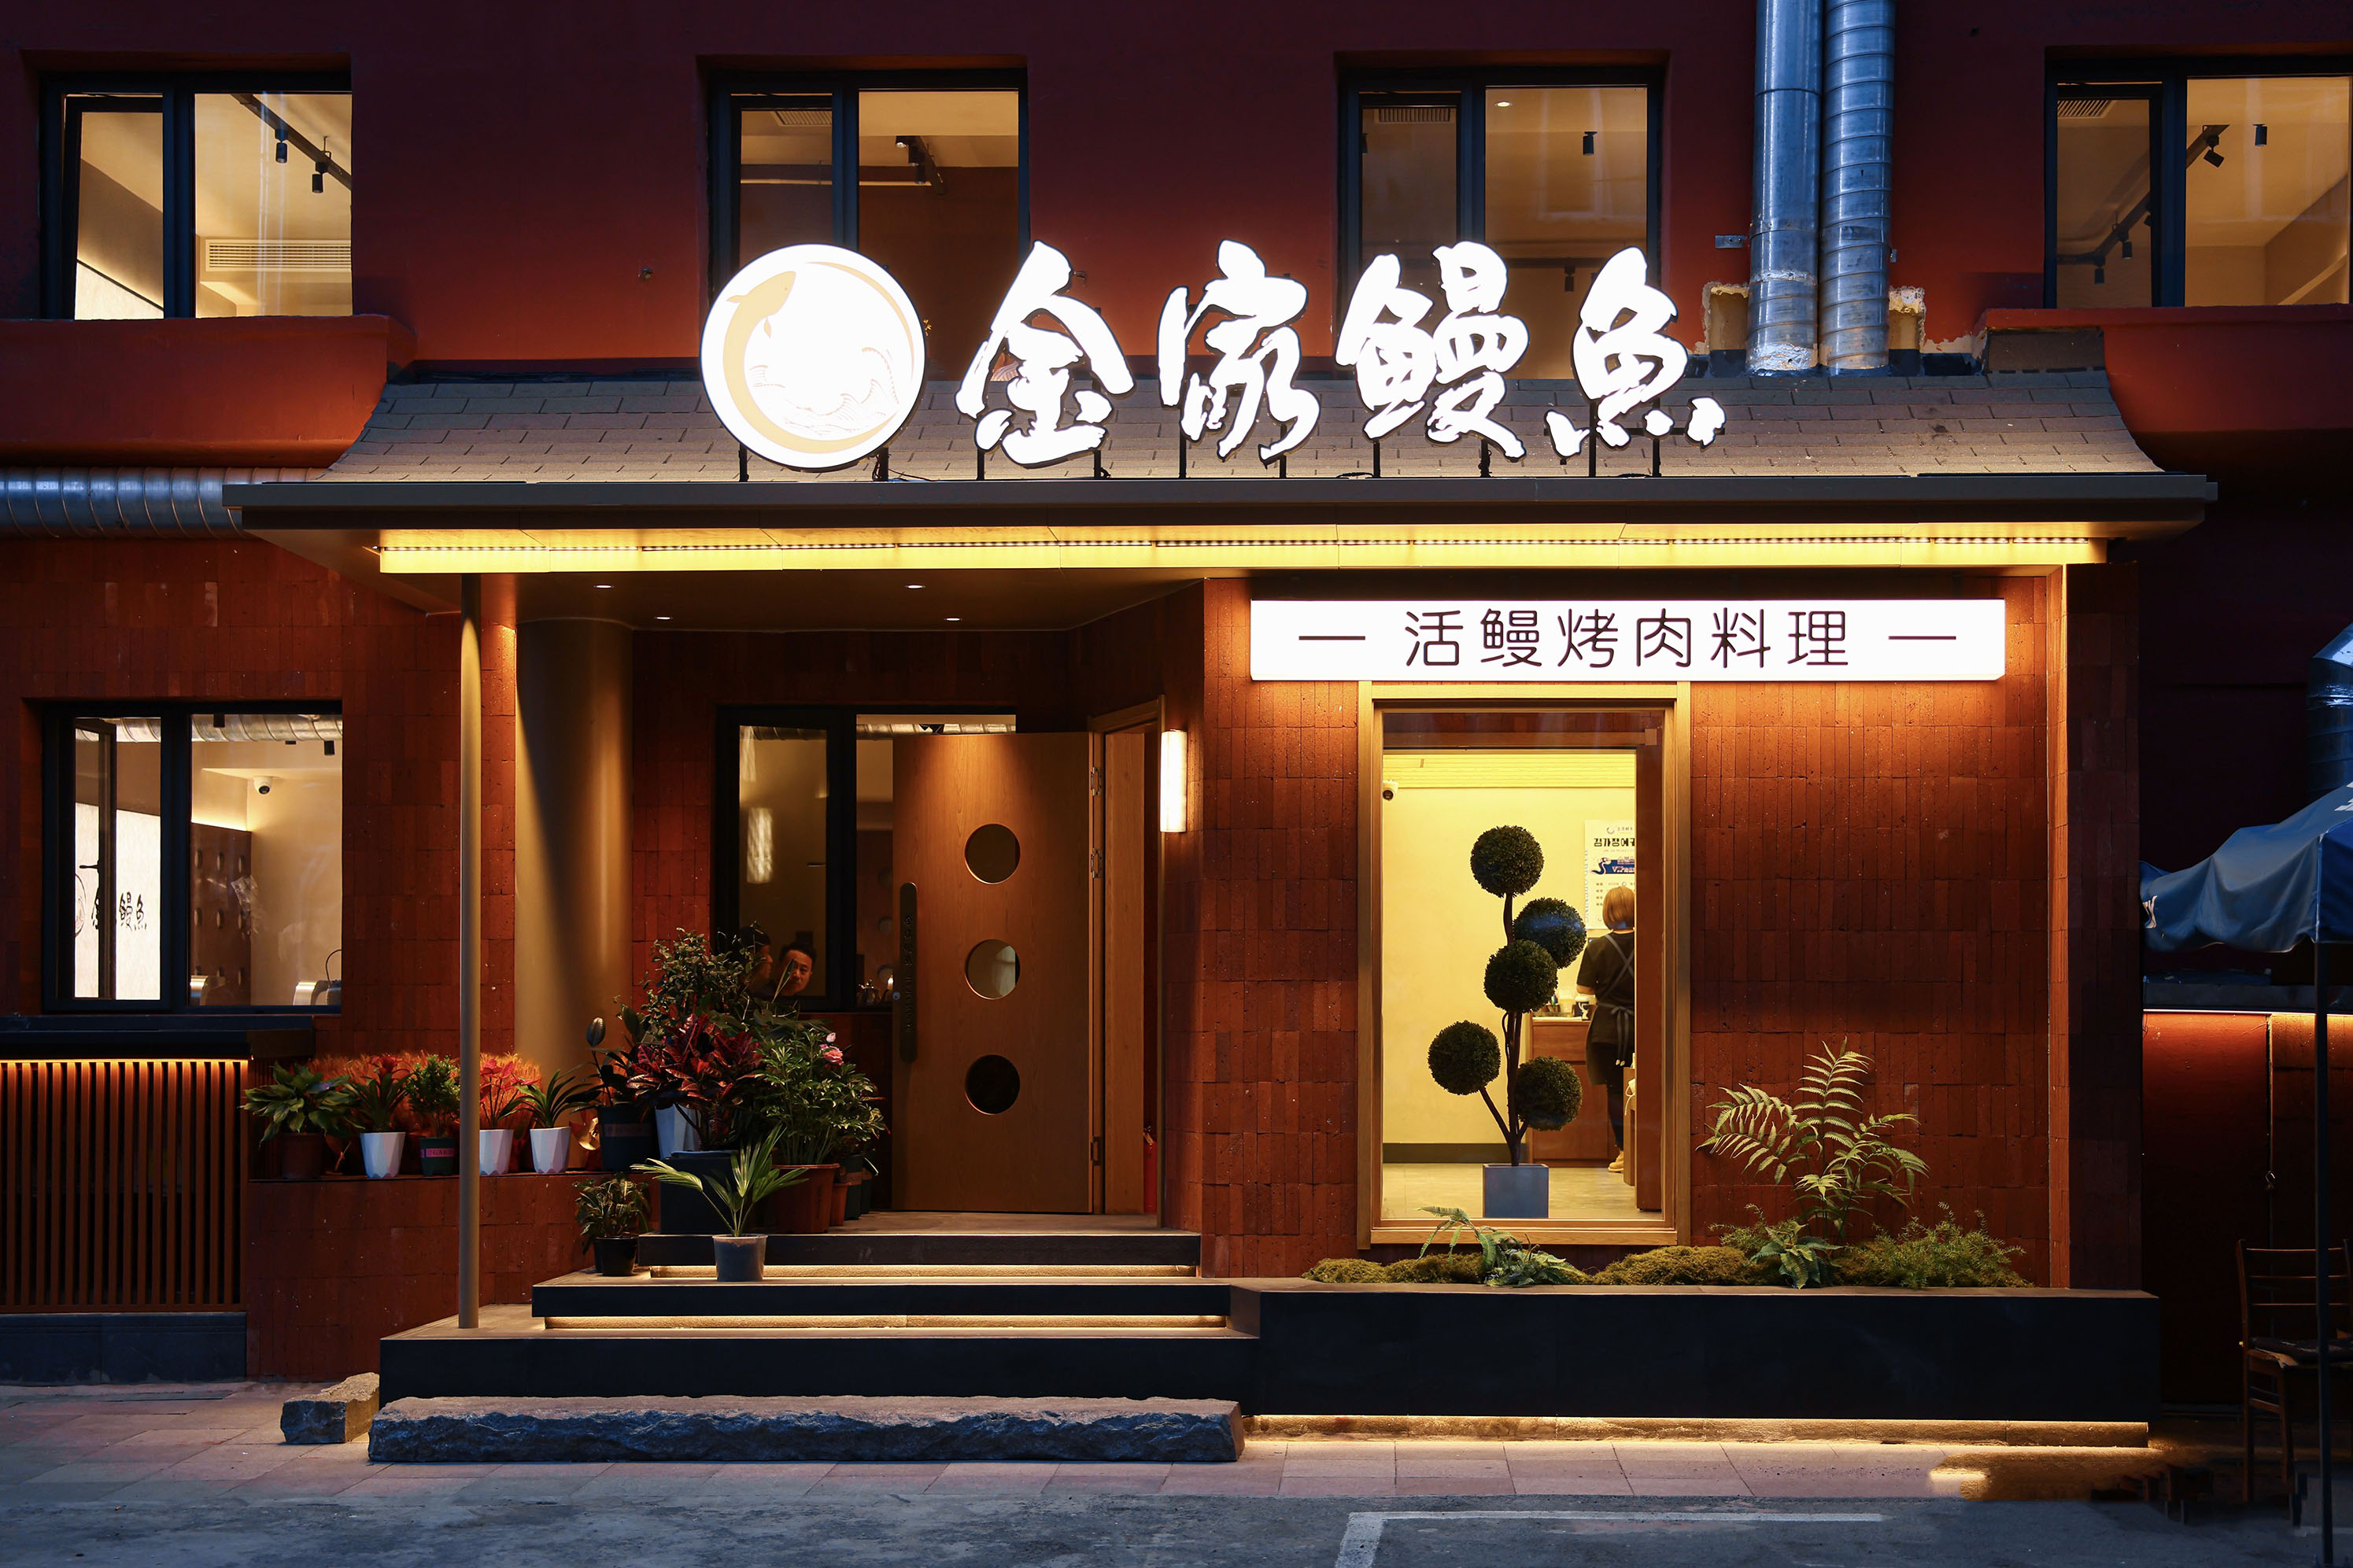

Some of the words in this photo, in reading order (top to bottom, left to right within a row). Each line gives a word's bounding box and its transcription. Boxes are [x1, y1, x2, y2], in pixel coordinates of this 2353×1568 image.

[1405, 607, 1849, 669] 活鳗烤肉料理
